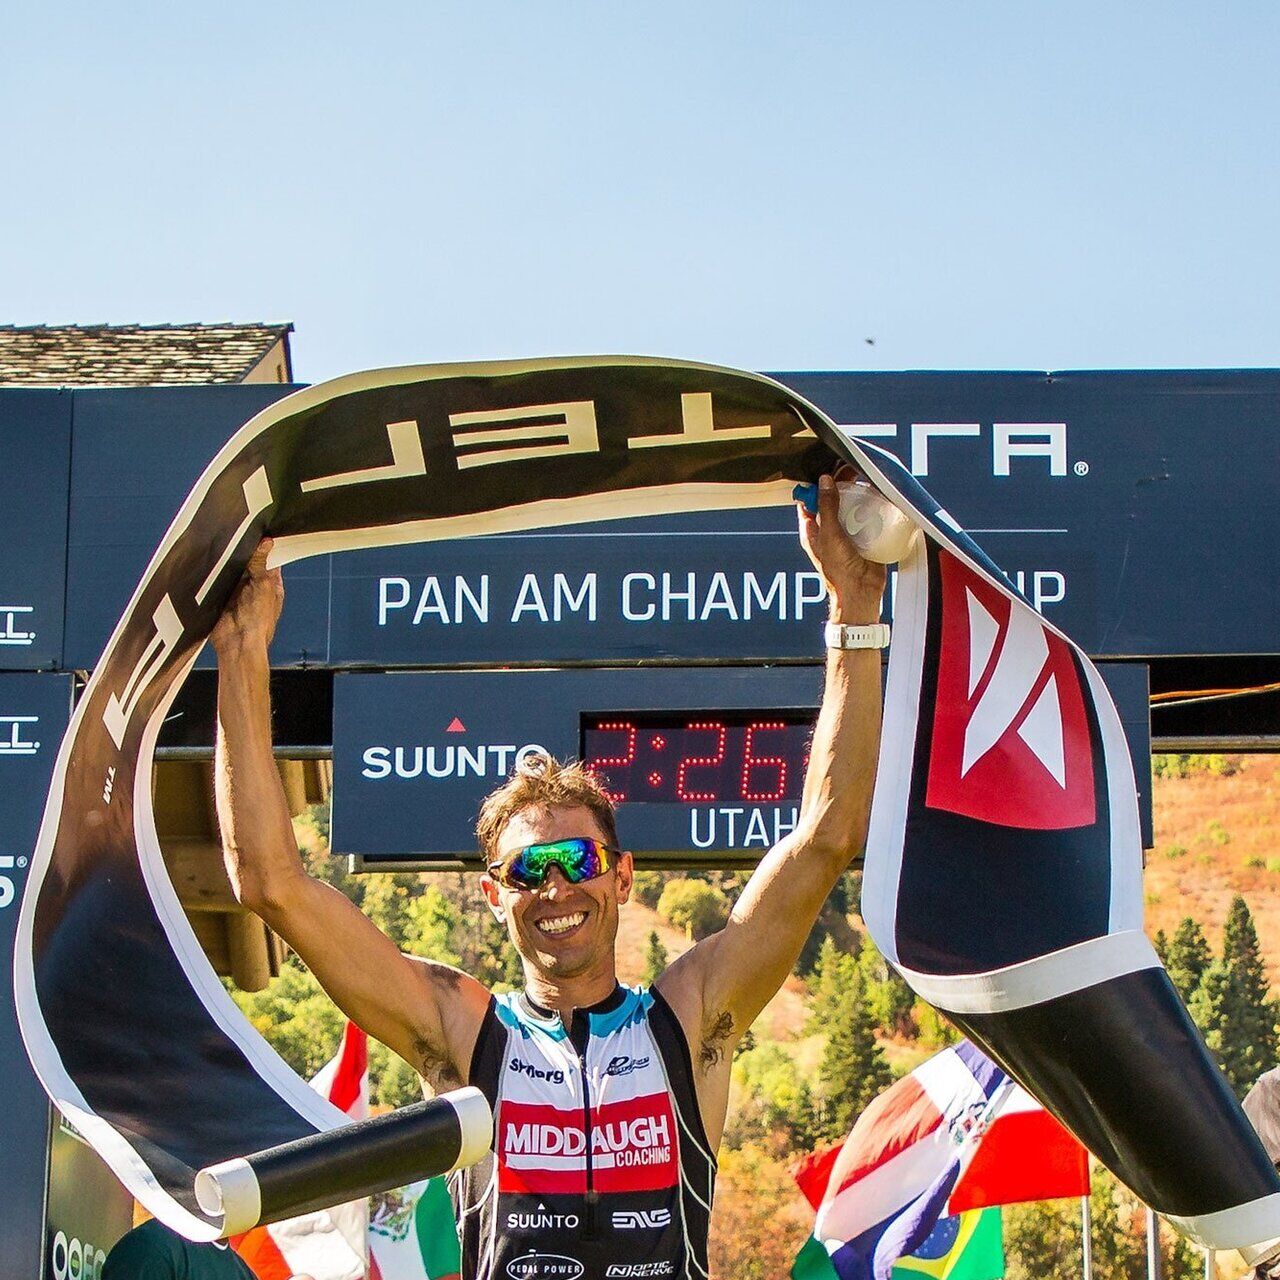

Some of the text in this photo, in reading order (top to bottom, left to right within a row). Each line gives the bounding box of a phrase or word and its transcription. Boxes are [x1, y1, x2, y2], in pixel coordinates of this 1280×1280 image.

[377, 570, 1066, 626] PAN AM CHAMPP
[690, 808, 798, 848] UTAH
[505, 1114, 671, 1156] MIDDAUGH
[616, 1145, 671, 1167] COACHING
[507, 1213, 579, 1229] SUUNTO
[510, 1264, 581, 1274] PEDAL POWER
[630, 1267, 674, 1278] NERVE
[632, 1260, 671, 1271] OPTIC
